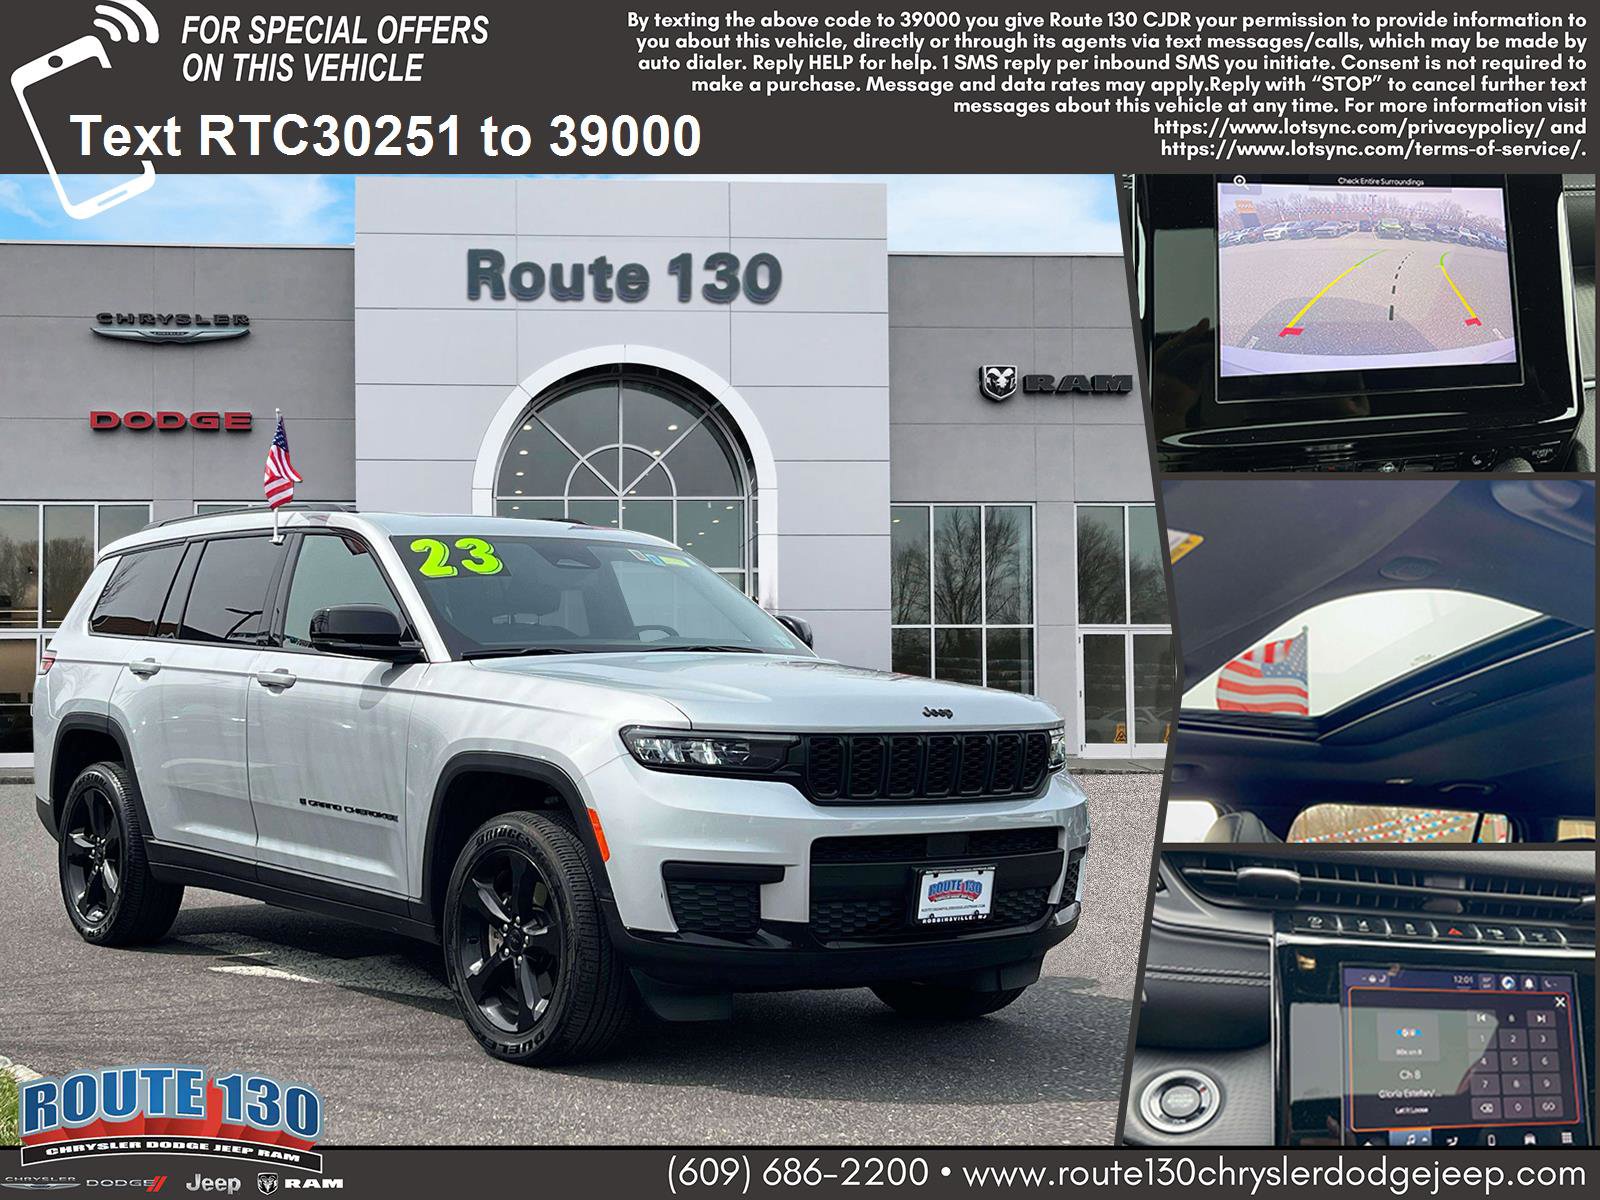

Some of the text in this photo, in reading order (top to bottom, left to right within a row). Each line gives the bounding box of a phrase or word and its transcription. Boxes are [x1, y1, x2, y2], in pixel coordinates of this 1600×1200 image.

[467, 248, 782, 304] Route 130
[96, 313, 250, 326] CHRYSLER
[1023, 374, 1133, 394] RAM
[90, 411, 252, 431] DODGE
[410, 537, 504, 578] 23
[922, 706, 953, 719] Jeep
